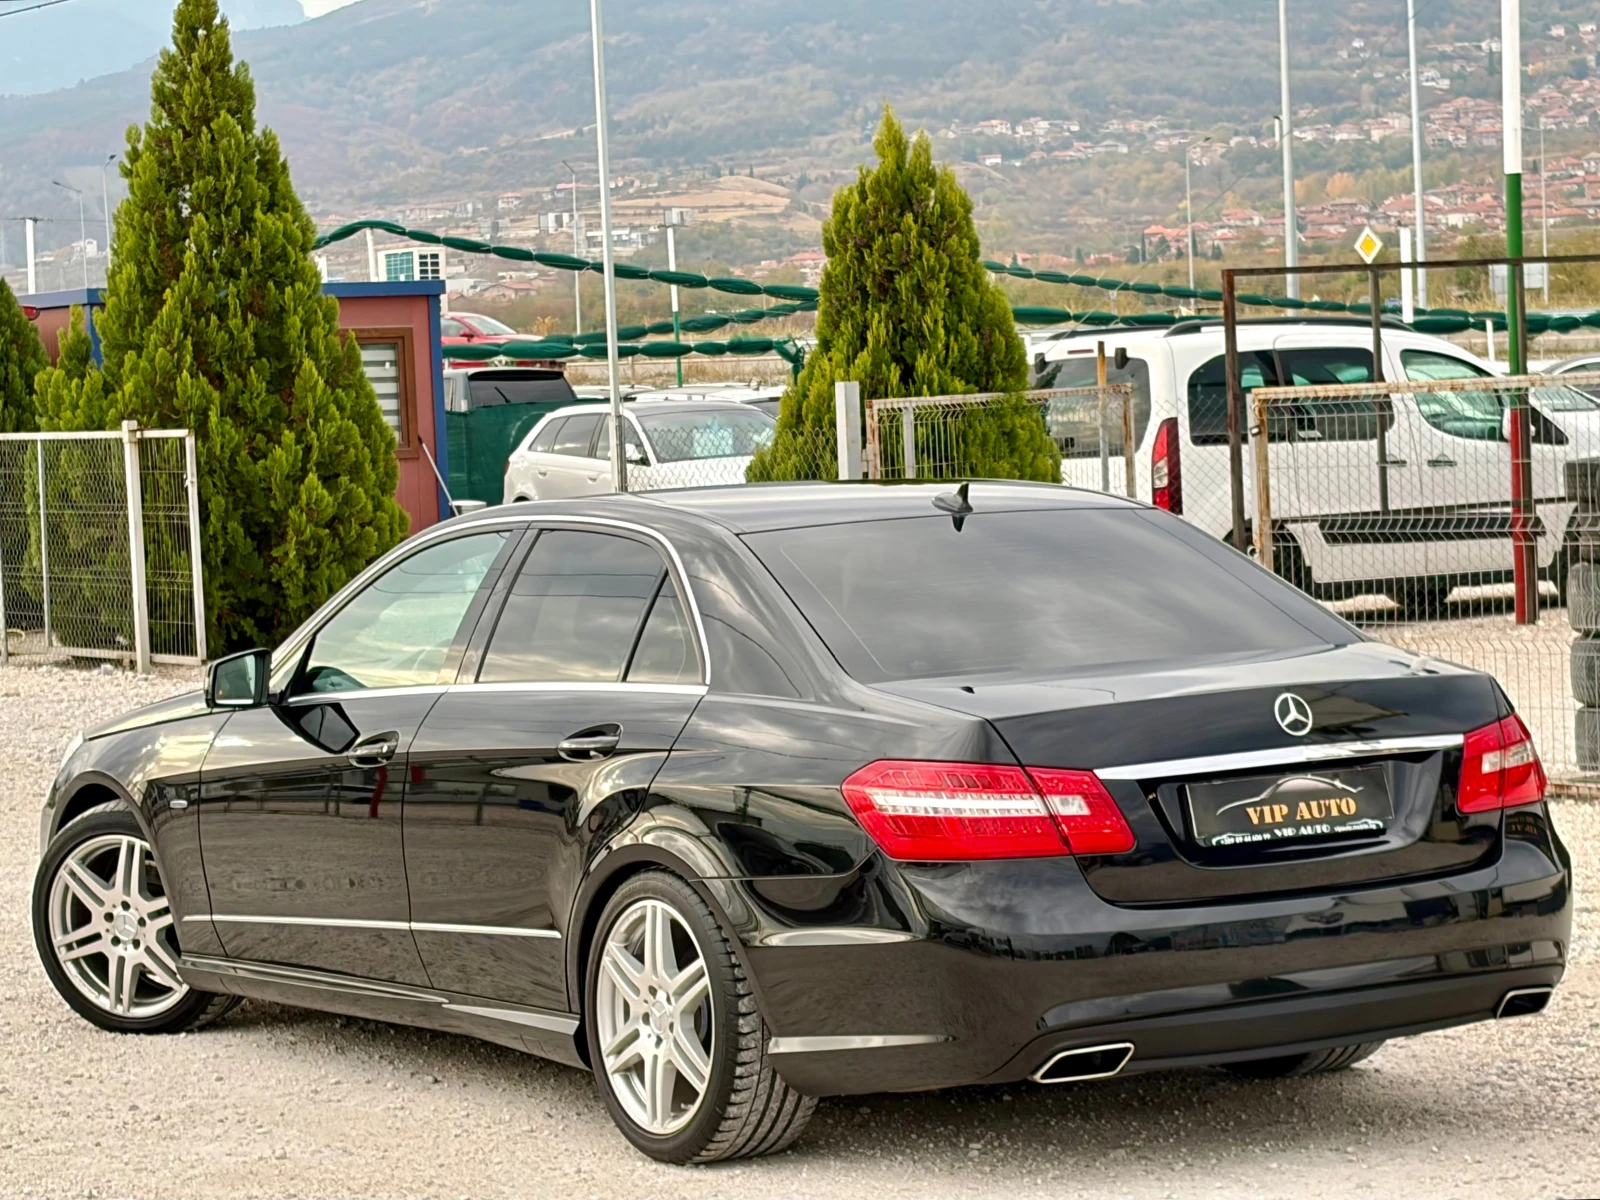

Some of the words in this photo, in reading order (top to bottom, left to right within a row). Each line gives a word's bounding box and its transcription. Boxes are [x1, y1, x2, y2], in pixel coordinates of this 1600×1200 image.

[1245, 804, 1289, 825] VIP
[1296, 797, 1356, 820] AUTO
[1273, 827, 1296, 837] VIP
[1299, 823, 1331, 835] AUTO
